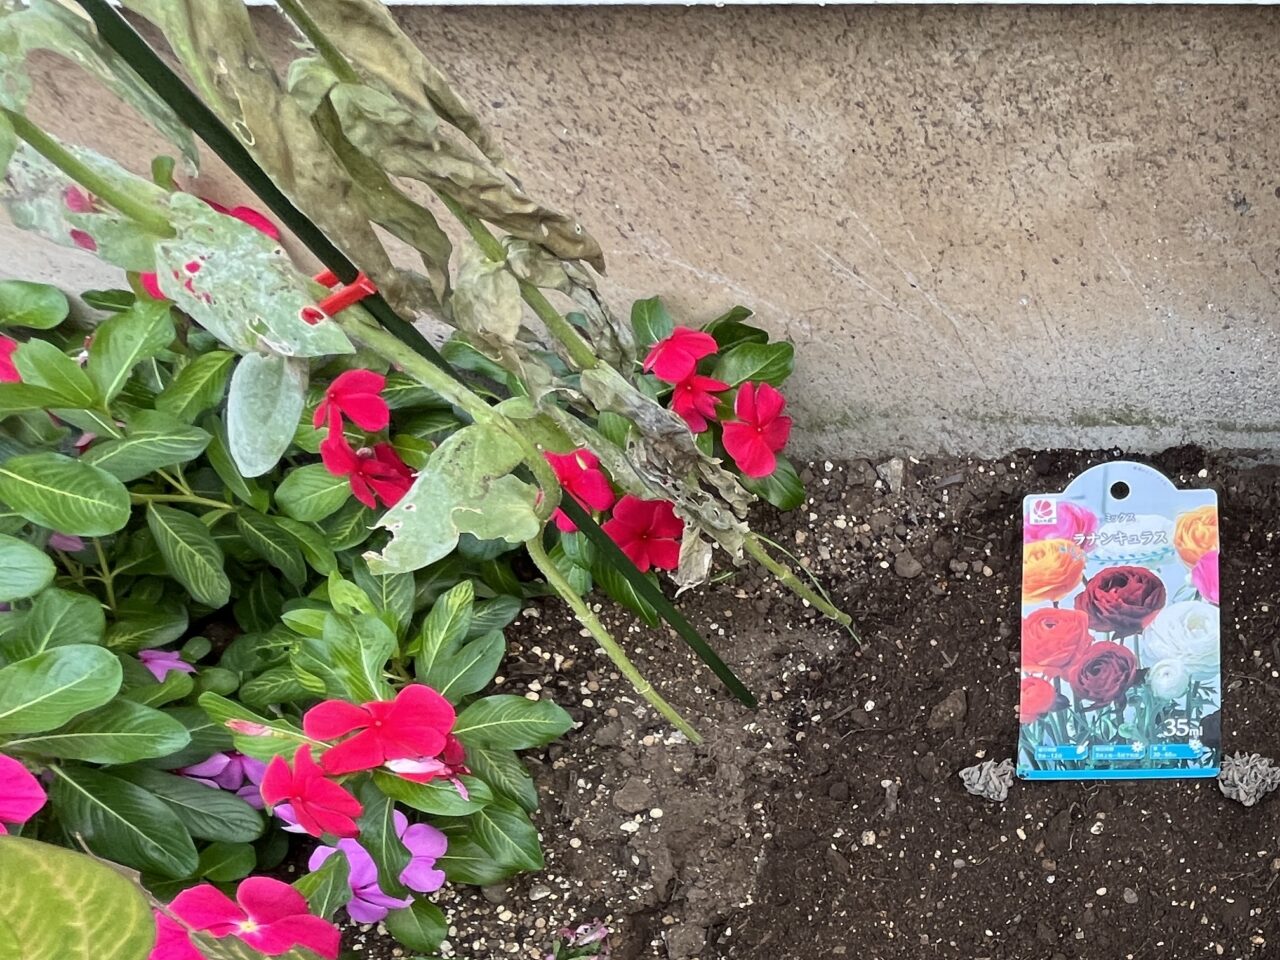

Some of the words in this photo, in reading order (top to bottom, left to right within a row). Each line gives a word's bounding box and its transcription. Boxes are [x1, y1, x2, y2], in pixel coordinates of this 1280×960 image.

[1105, 513, 1136, 523] ミックス
[1073, 531, 1168, 545] ラナンキュラス
